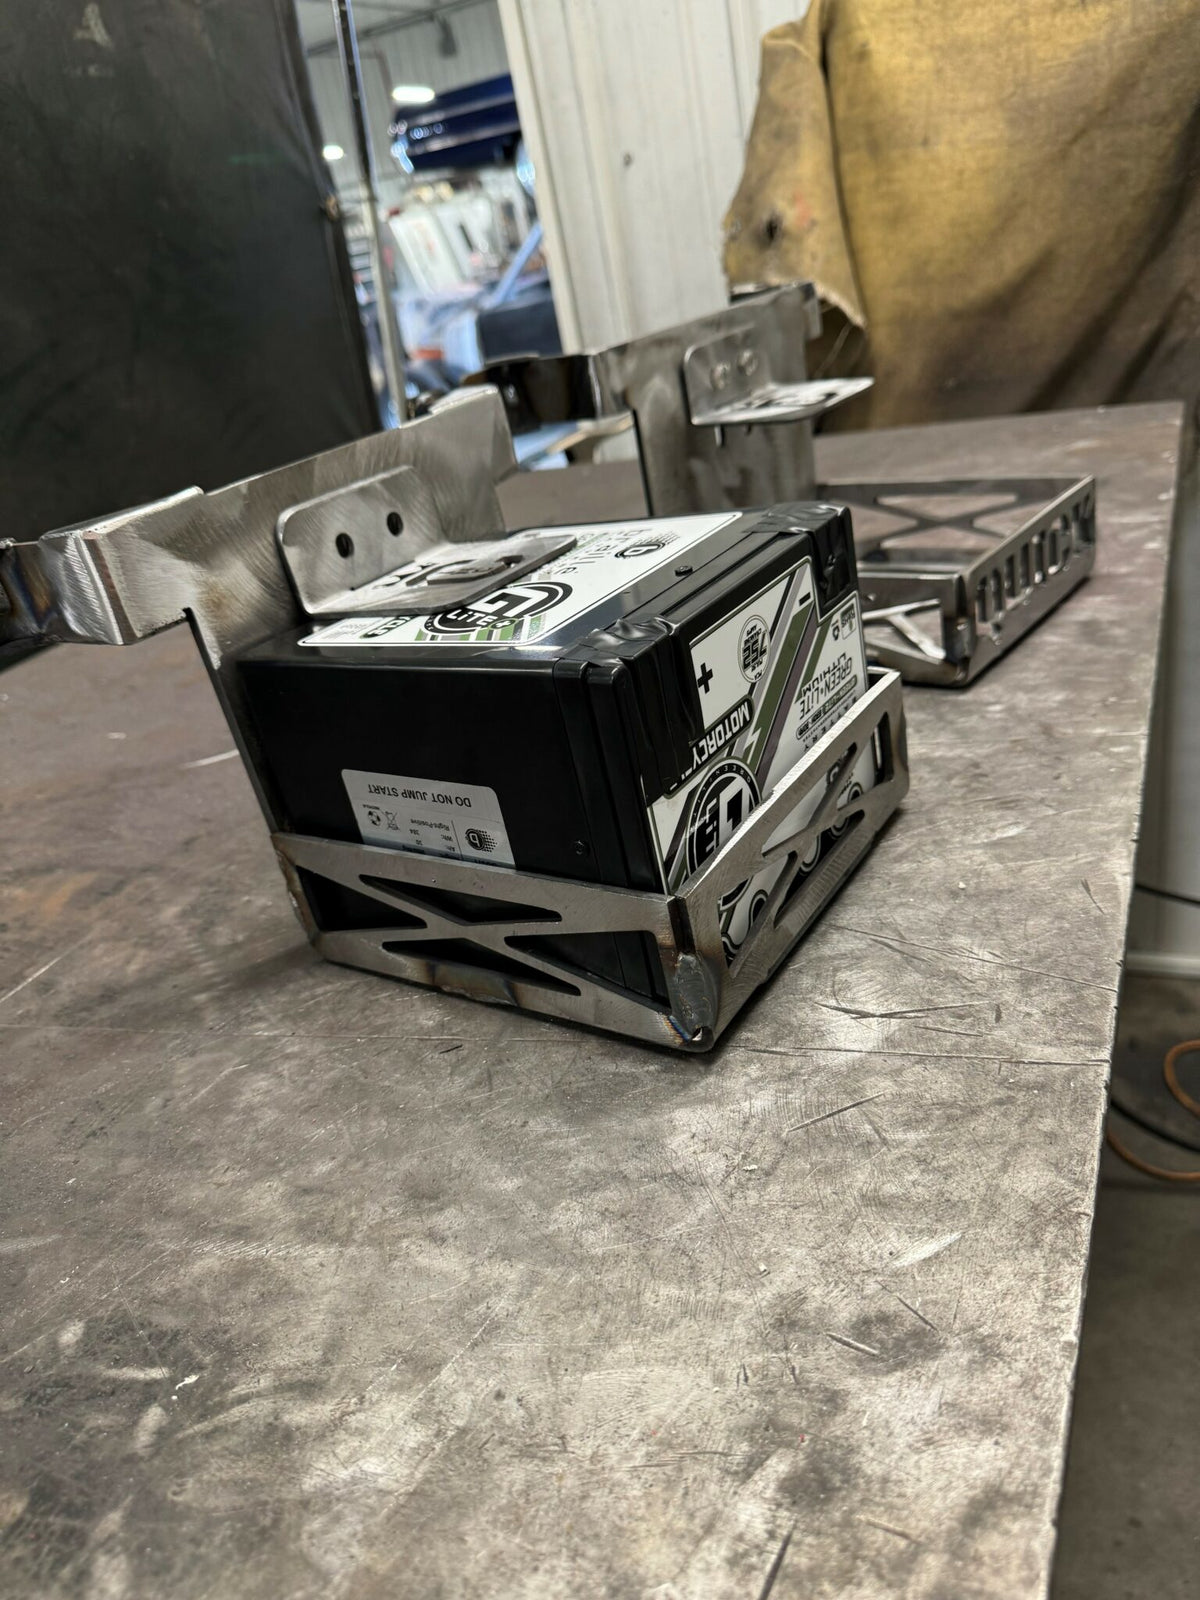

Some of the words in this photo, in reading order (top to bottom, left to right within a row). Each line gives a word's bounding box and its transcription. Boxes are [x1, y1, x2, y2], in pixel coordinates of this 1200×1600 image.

[743, 629, 768, 670] 752
[802, 652, 847, 695] LITHIUM
[367, 783, 399, 797] START
[401, 789, 428, 801] JUMP
[431, 793, 453, 805] NOT
[455, 796, 472, 808] DO
